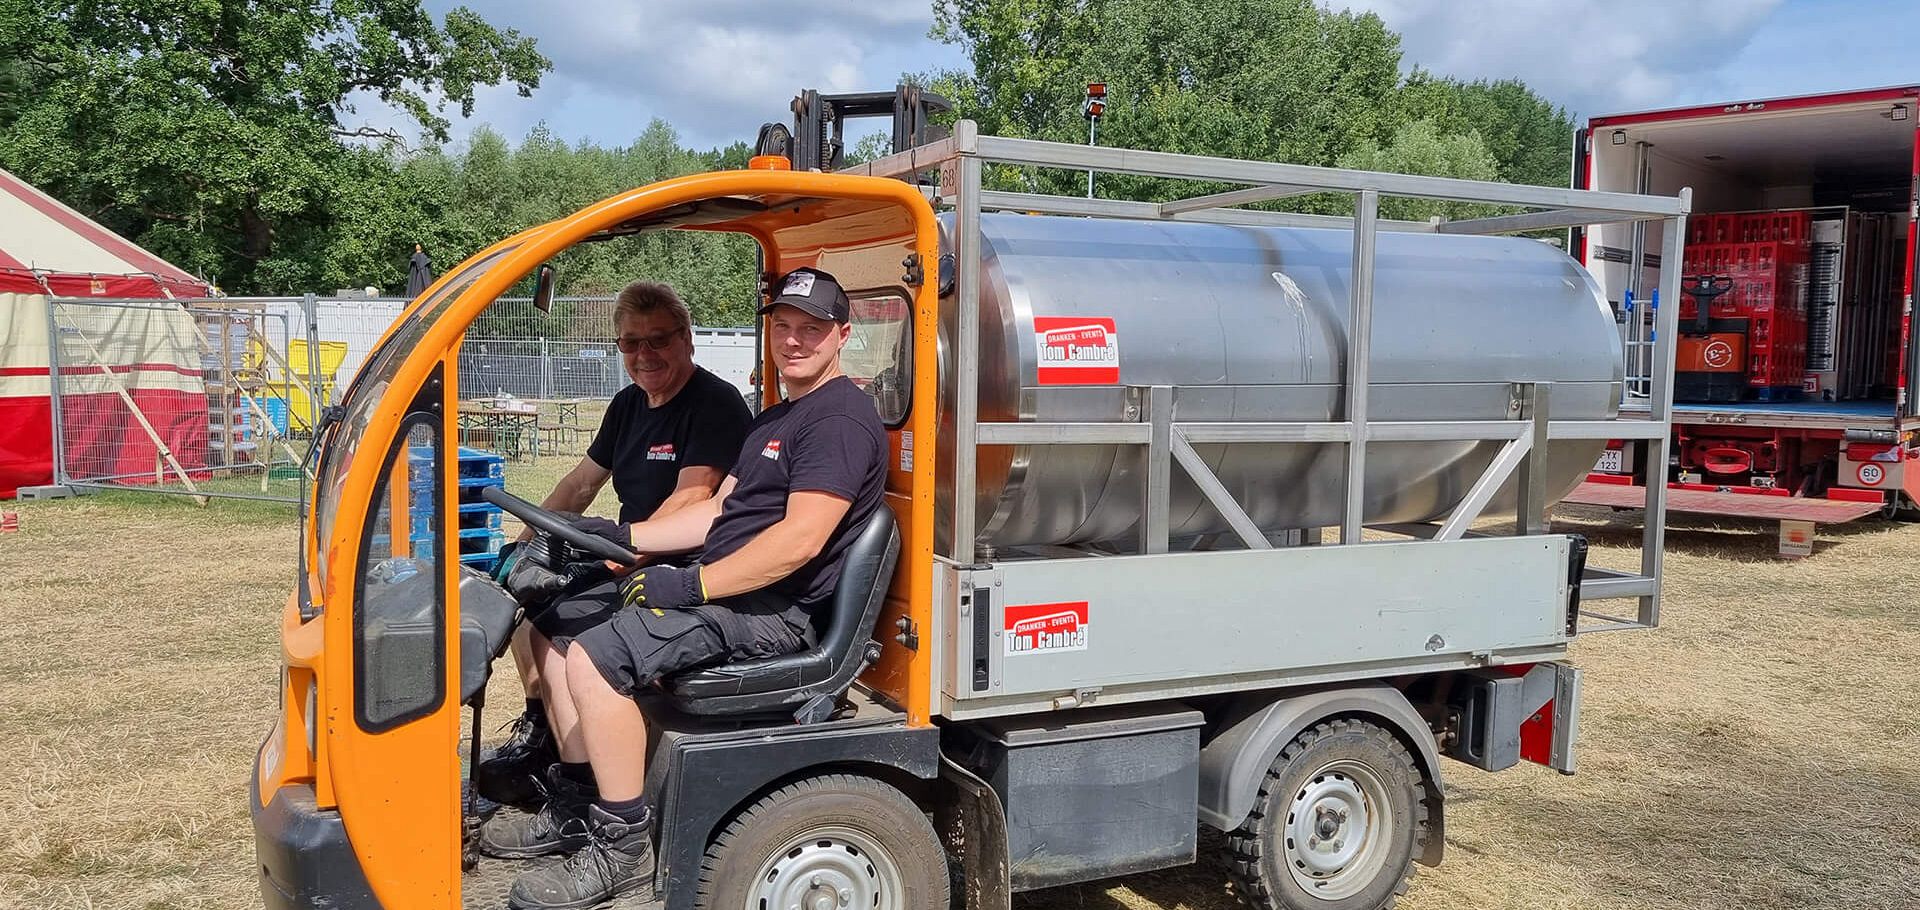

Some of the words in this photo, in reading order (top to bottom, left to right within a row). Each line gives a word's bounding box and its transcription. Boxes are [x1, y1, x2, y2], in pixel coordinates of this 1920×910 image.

[943, 169, 954, 188] 68
[1048, 333, 1076, 343] DRANKEN
[1081, 329, 1104, 340] EVENTS
[1041, 343, 1065, 361] Tom
[1068, 343, 1114, 361] Cambré
[1601, 461, 1617, 470] 123
[1863, 467, 1879, 477] 60
[1017, 621, 1046, 633] DRANKEN
[1051, 615, 1074, 627] EVENTS
[1009, 633, 1033, 652] Tom
[1038, 628, 1084, 649] Cambré
